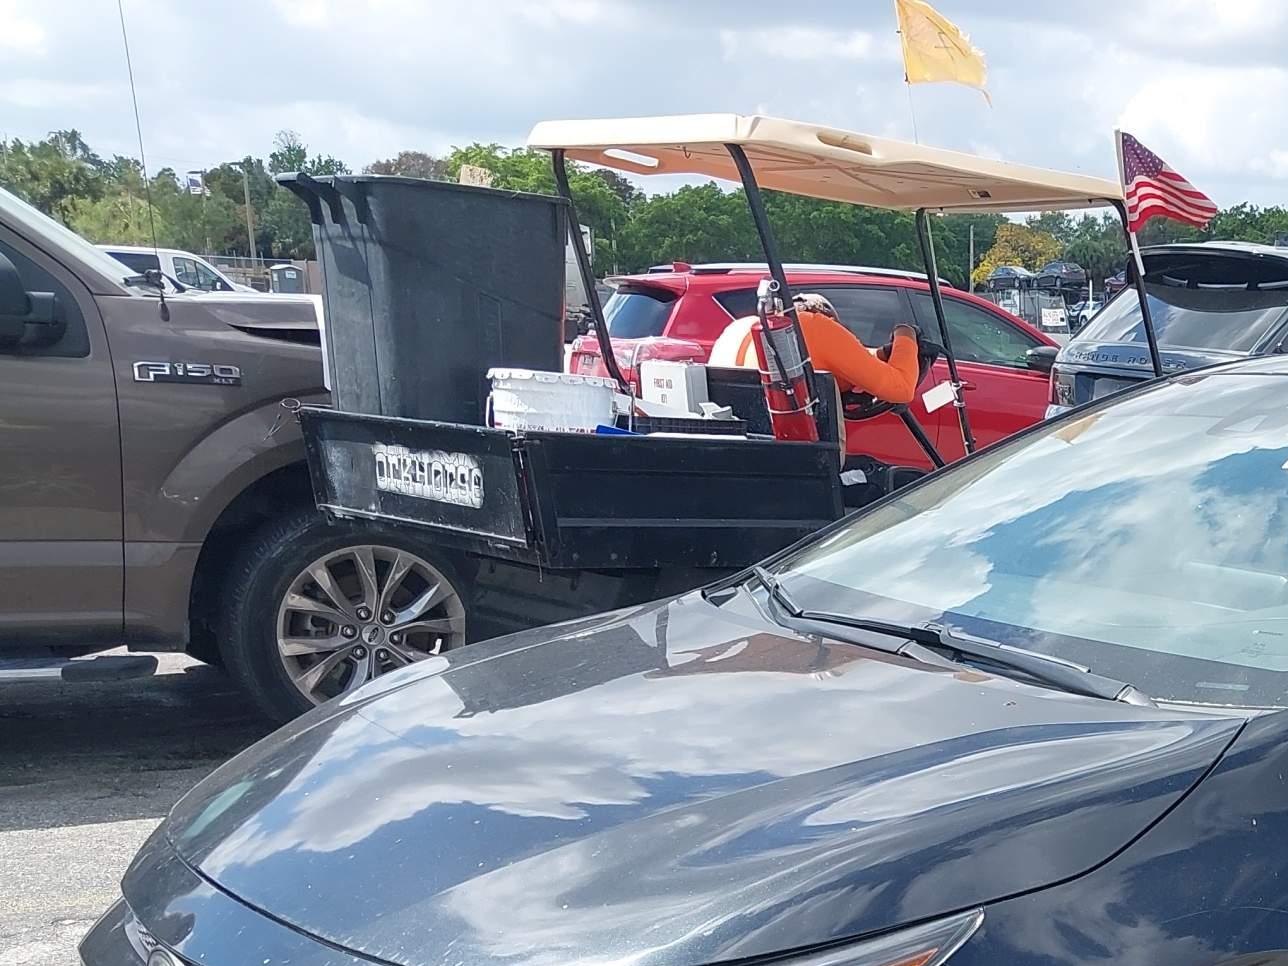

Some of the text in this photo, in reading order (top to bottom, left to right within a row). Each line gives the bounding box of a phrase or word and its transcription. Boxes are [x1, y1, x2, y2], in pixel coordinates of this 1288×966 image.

[1127, 356, 1186, 369] ROER
[133, 361, 241, 381] F150
[213, 377, 234, 385] XLT
[653, 378, 665, 389] FIRST
